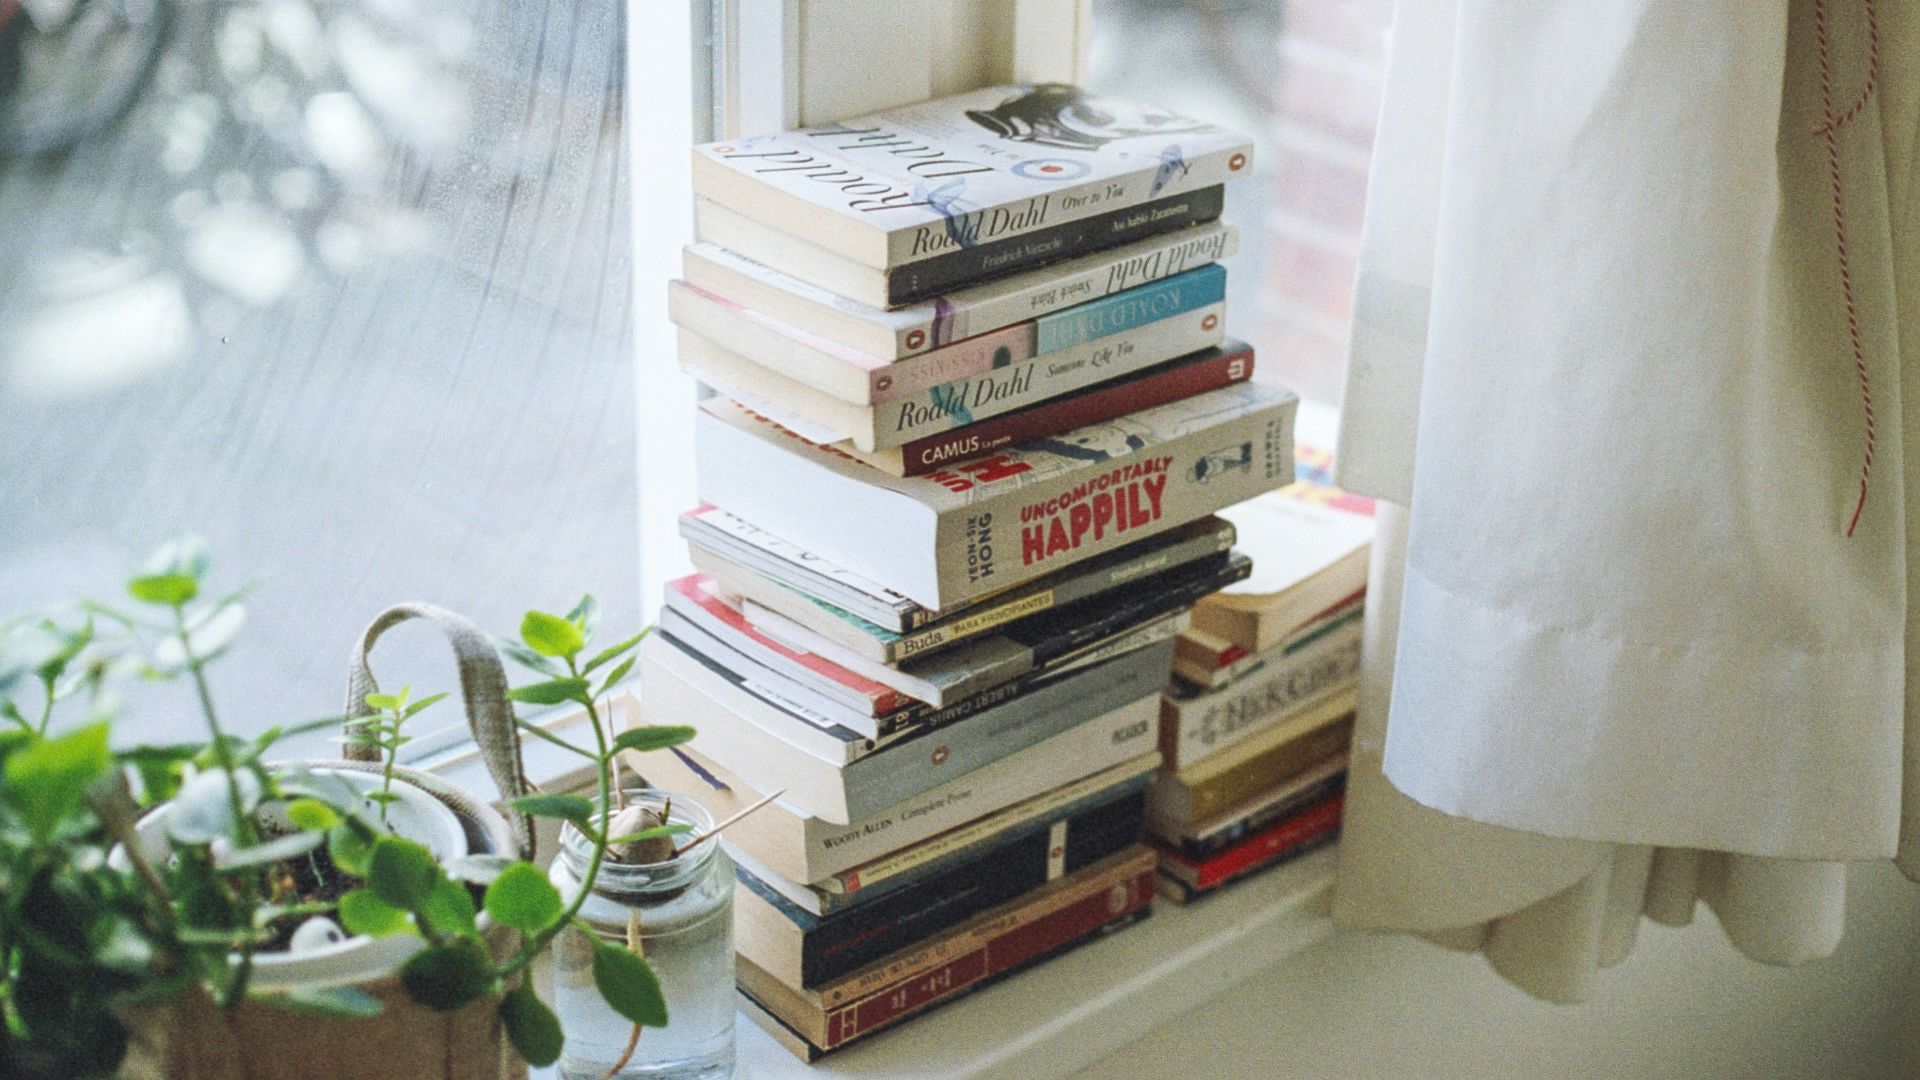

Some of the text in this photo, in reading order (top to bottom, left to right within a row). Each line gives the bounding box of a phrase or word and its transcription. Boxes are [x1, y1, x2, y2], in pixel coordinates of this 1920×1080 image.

[722, 150, 938, 212] Roald
[807, 127, 994, 178] Dahl
[909, 208, 983, 257] Roald
[985, 195, 1051, 238] Dahl
[1104, 183, 1126, 201] You
[1104, 250, 1163, 295] Dahl
[1164, 231, 1229, 276] Roald
[896, 378, 967, 432] Roald
[973, 362, 1035, 410] Dahl
[920, 434, 980, 465] CAMUS
[1019, 455, 1175, 524] UNCOMFORTABLY
[1021, 473, 1168, 567] HAPPILY
[965, 515, 978, 584] YEON-SIK
[978, 511, 994, 579] HONG
[902, 630, 944, 655] Buda
[952, 620, 980, 635] PARA
[975, 683, 1019, 710] ALBERT
